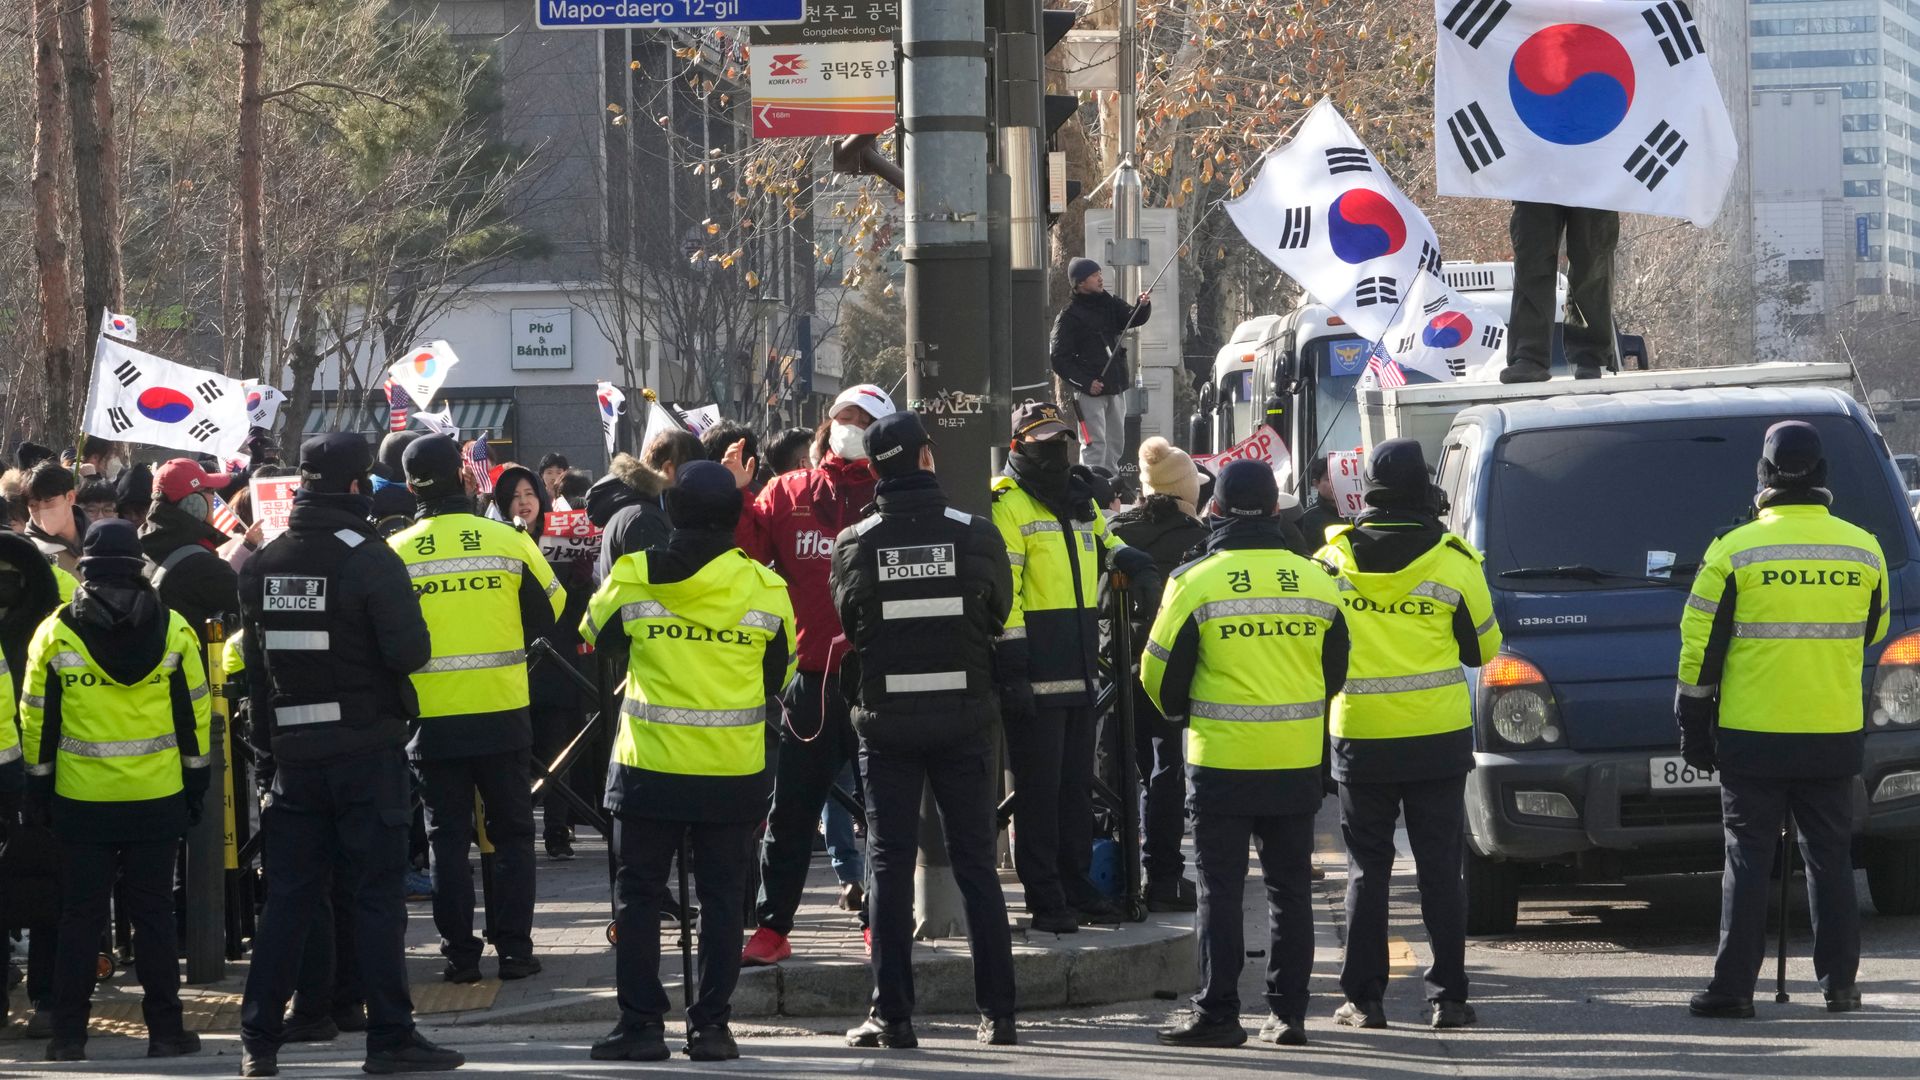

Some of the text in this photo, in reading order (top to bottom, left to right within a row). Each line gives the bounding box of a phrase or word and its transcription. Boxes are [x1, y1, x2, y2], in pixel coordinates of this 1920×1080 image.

[549, 0, 739, 22] Mapo-daero 12-gil
[806, 5, 857, 23] 천주교
[802, 26, 876, 37] Gongdeok-dong
[820, 60, 895, 81] 공덕2동우
[529, 322, 553, 334] Phở
[538, 336, 545, 344] &
[517, 344, 566, 357] Bánh mì
[938, 417, 966, 427] 마포구
[879, 446, 902, 460] POLICE
[887, 563, 947, 579] POLICE
[1761, 569, 1861, 586] POLICE
[269, 597, 317, 609] POLICE
[647, 624, 752, 645] POLICE
[1219, 622, 1317, 639] POLICE
